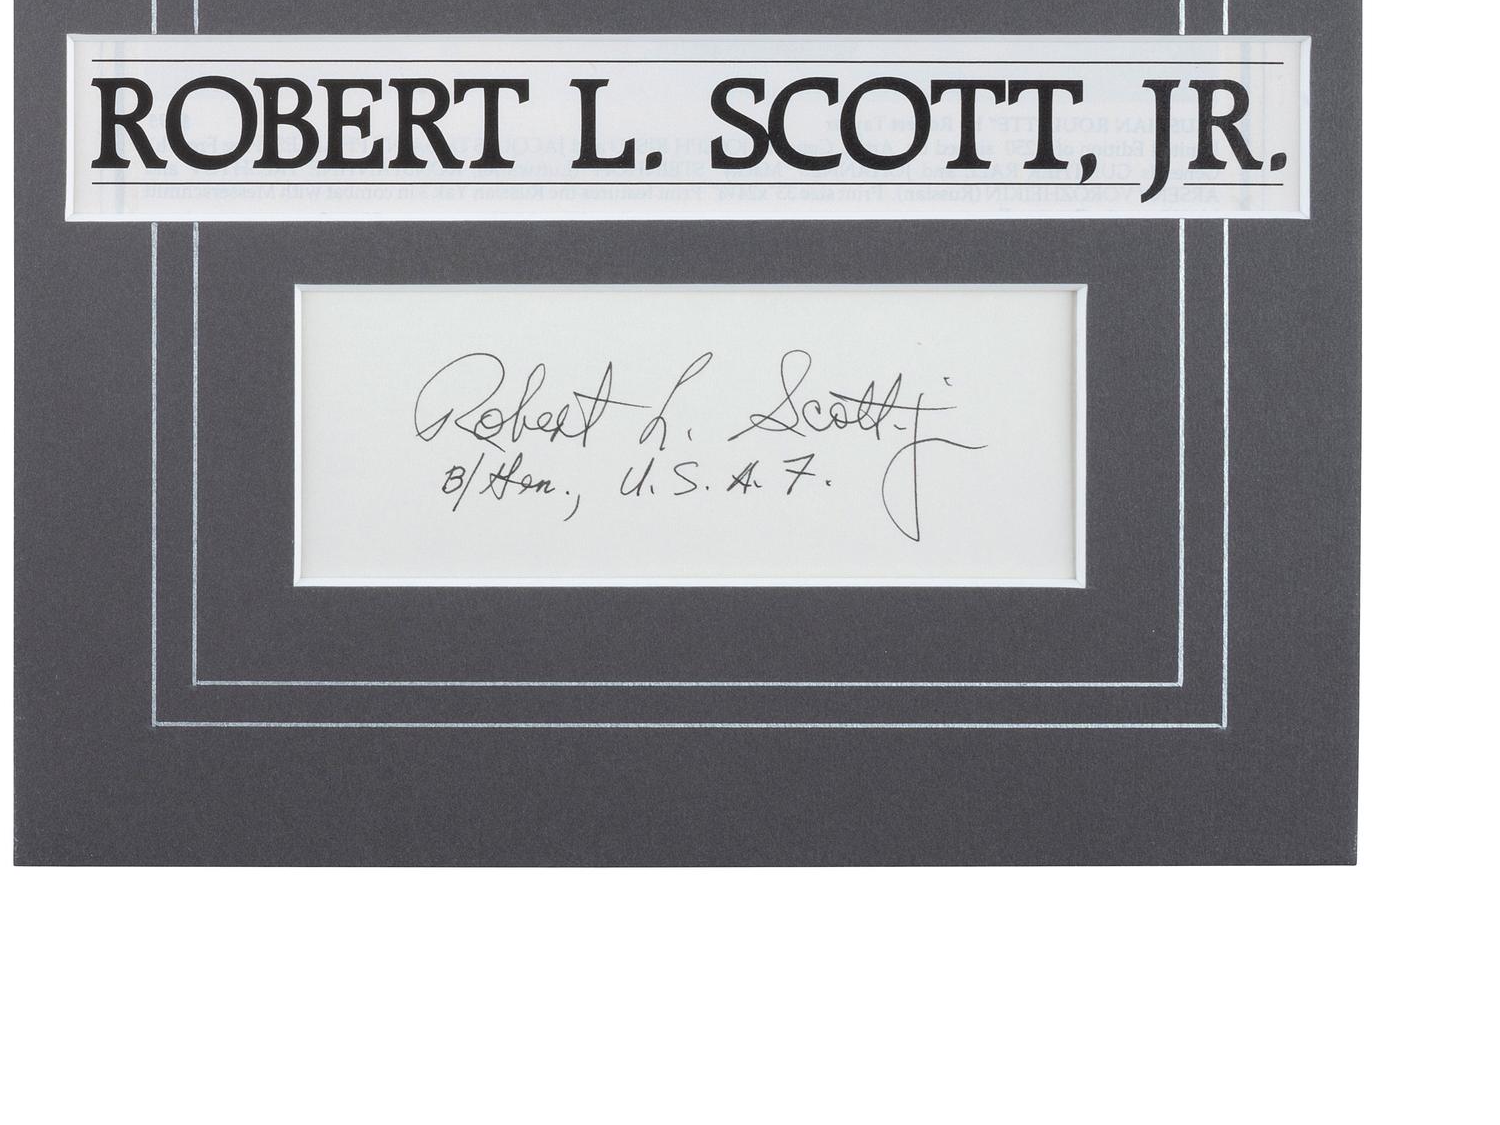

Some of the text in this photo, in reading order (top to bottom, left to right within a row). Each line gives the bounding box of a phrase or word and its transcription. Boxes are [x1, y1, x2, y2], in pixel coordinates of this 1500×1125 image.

[91, 76, 1286, 203] ROBERT L. SCOTT, JR.
[415, 353, 651, 452] Robert
[639, 352, 713, 451] L.
